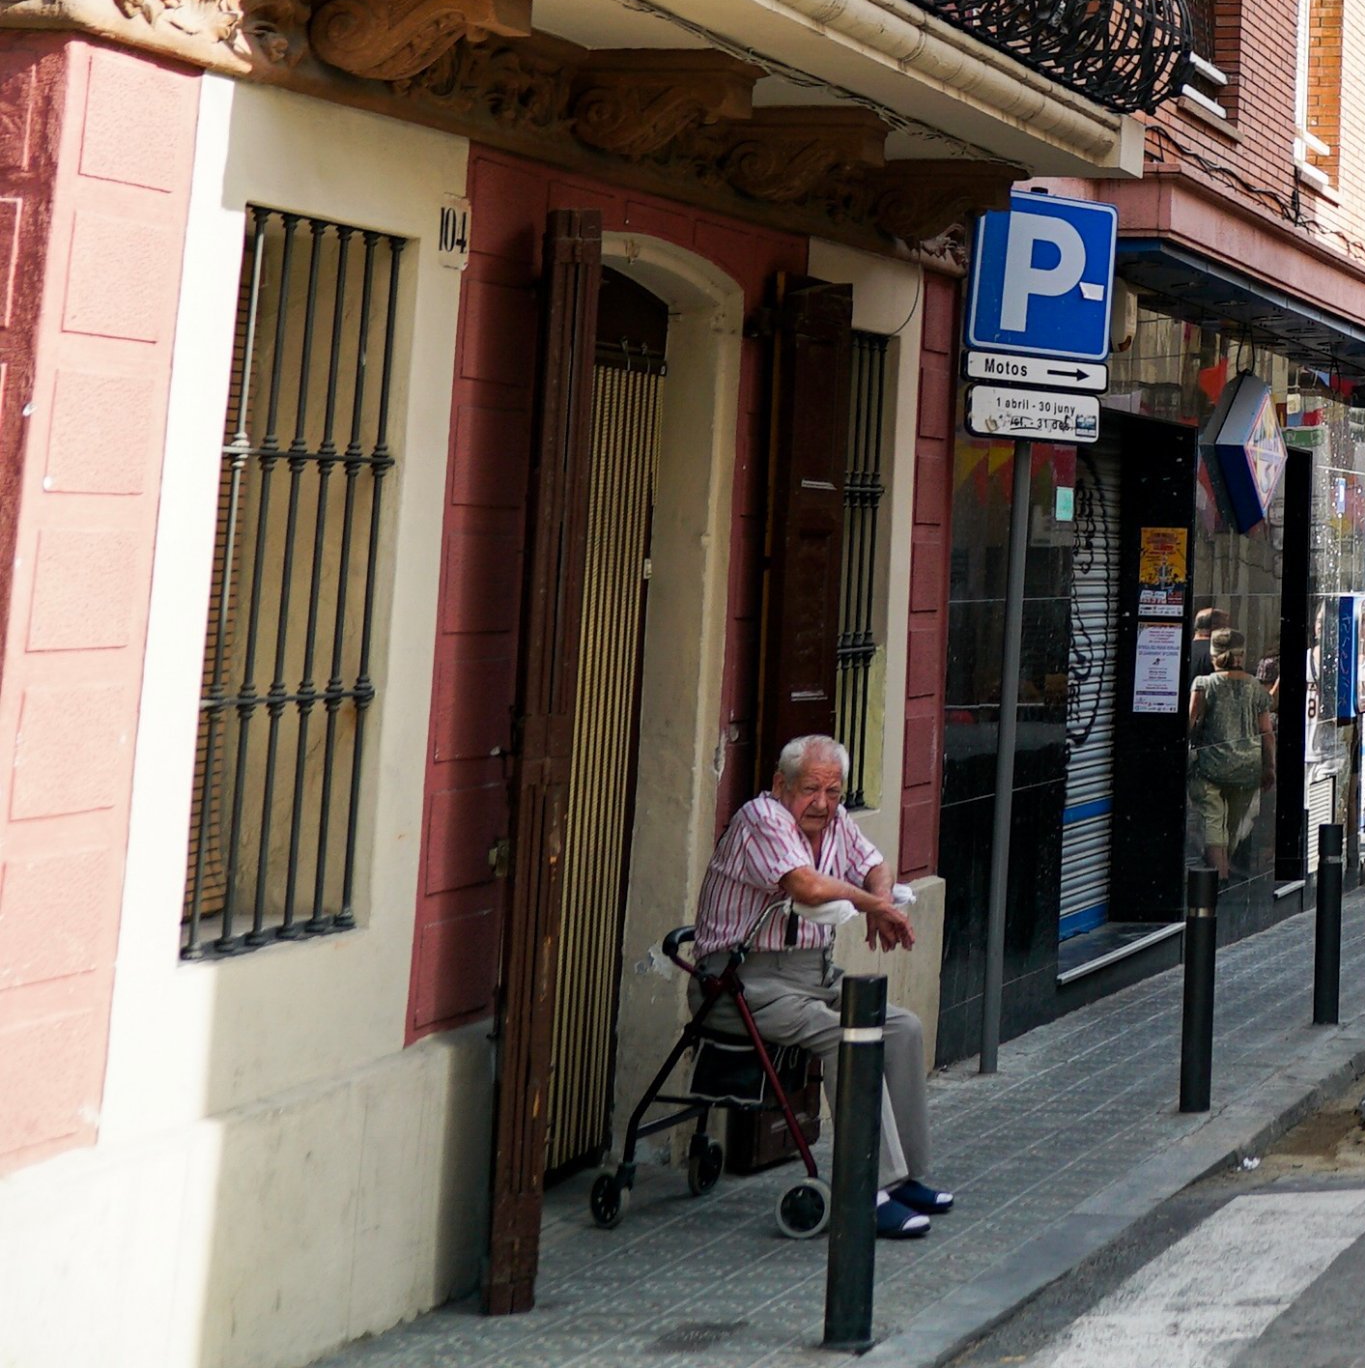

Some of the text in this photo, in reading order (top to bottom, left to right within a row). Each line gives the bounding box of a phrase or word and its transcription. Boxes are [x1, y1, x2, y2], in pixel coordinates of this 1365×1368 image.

[439, 207, 467, 253] 104
[1000, 210, 1086, 332] P
[984, 358, 1028, 377] Motos
[996, 397, 1000, 406] 1
[1005, 398, 1029, 410] abril
[1039, 401, 1051, 411] 30
[1053, 402, 1076, 415] juny
